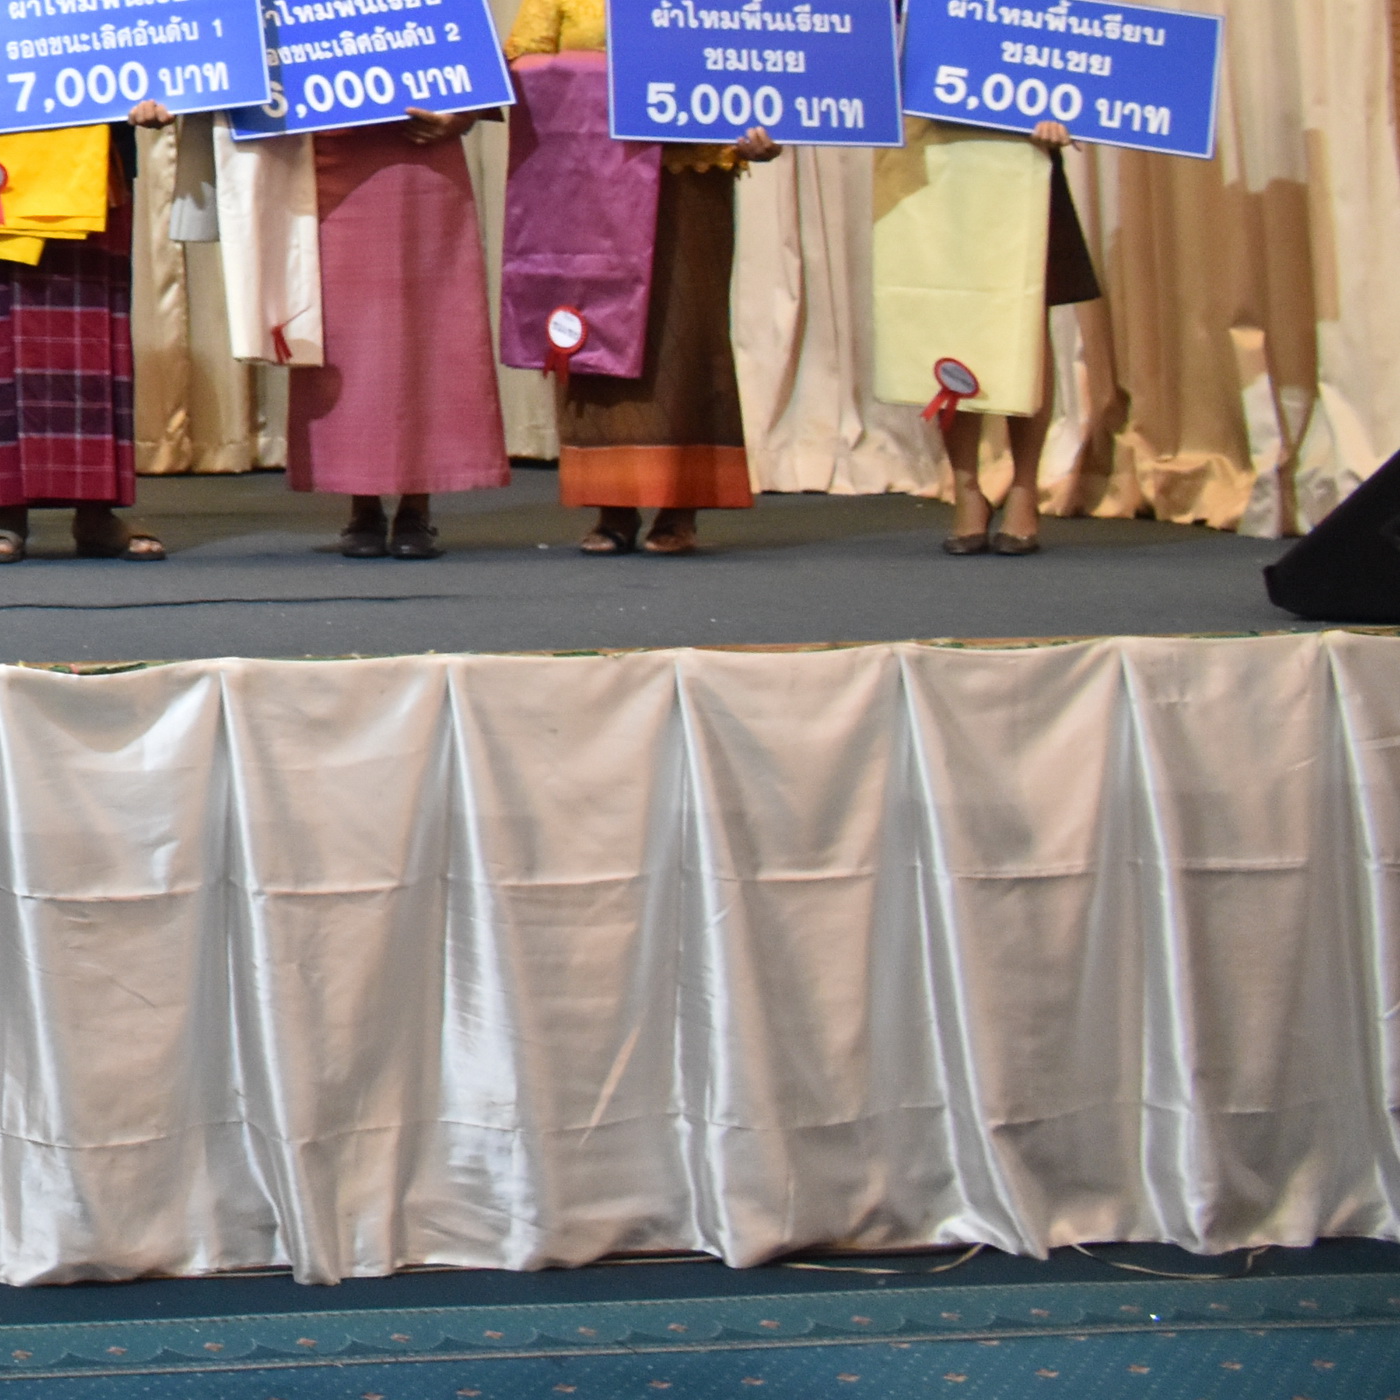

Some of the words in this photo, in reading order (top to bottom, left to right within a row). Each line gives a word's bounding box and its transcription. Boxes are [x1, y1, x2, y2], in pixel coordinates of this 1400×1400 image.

[211, 17, 223, 38] 1
[266, 20, 437, 67] องชนะเลิศอันดับ
[445, 22, 461, 42] 2
[703, 47, 806, 73] ชมเชย
[1000, 40, 1113, 77] ชมเชย
[6, 60, 149, 113] 7,000
[158, 60, 230, 97] บาท
[401, 63, 473, 100] บาท
[933, 64, 1084, 123] 5,000
[1095, 98, 1171, 137] บาท
[646, 81, 783, 127] 5,000
[794, 96, 865, 129] บาท
